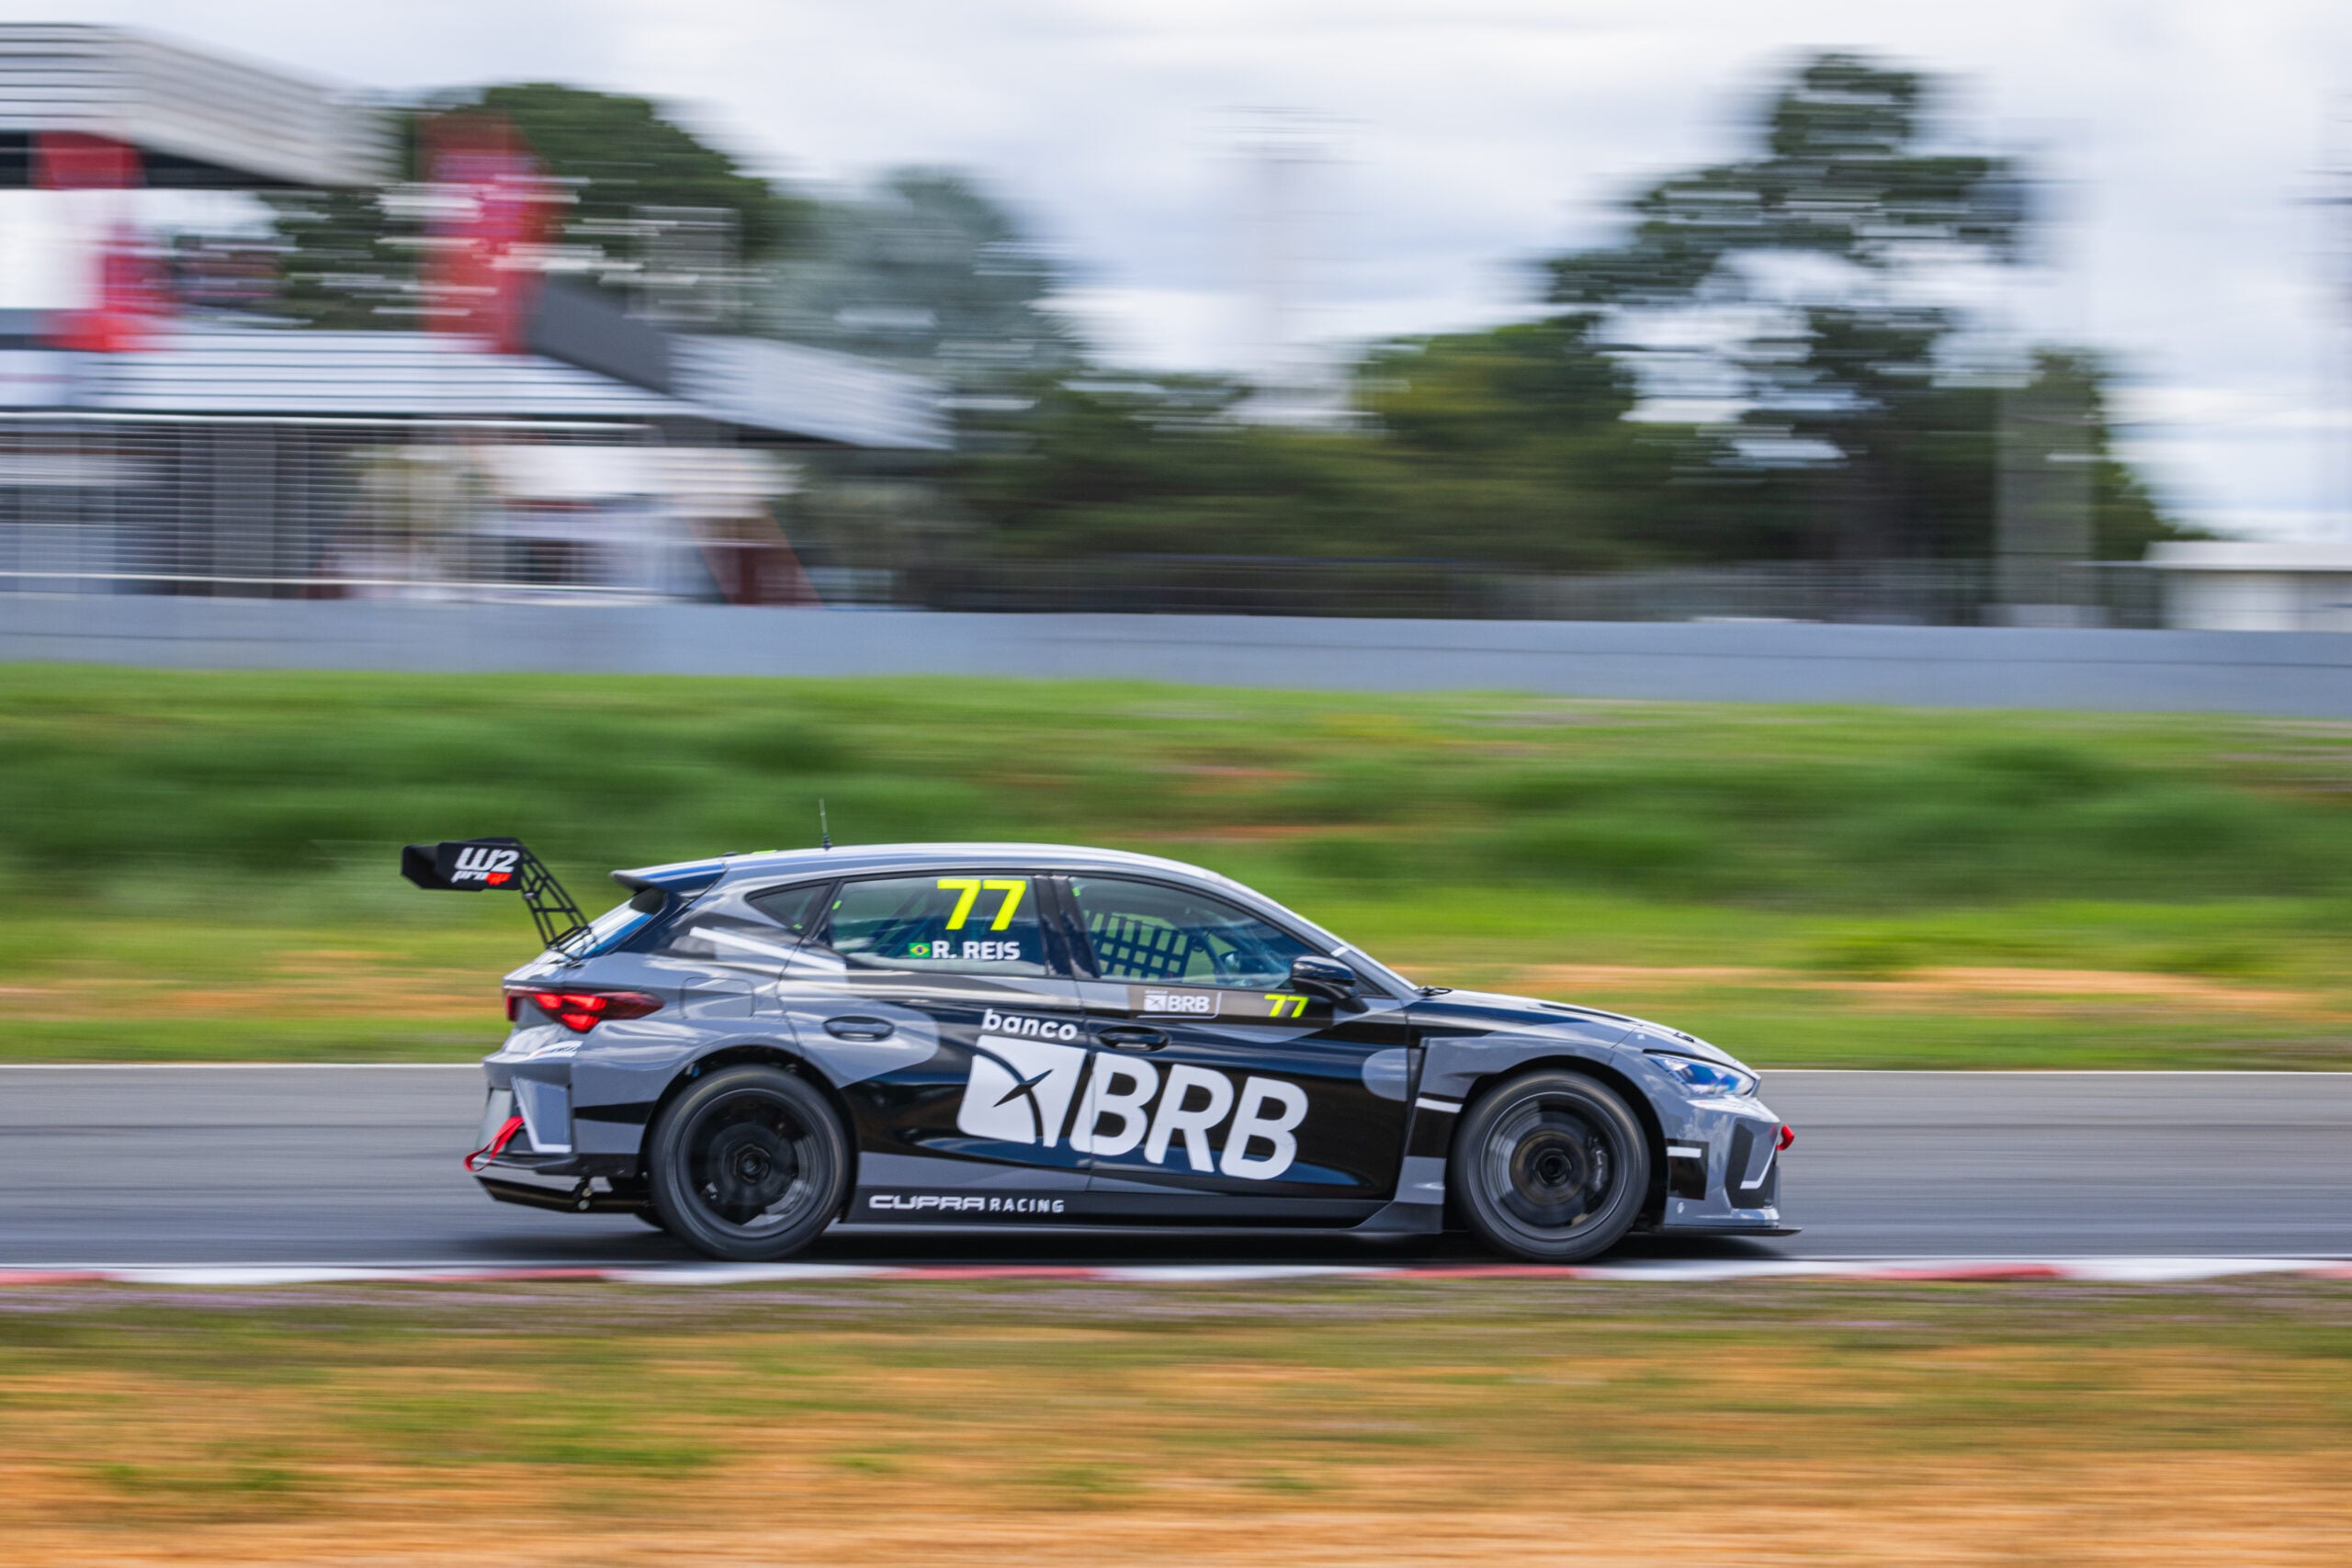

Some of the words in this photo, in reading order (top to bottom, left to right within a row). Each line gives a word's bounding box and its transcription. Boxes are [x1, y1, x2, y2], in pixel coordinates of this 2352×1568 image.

[454, 847, 520, 873] W2
[937, 878, 1026, 931] 77
[932, 940, 957, 959] R.
[962, 941, 1021, 961] REIS
[1168, 995, 1211, 1013] BRB
[1264, 993, 1309, 1019] 77
[981, 1009, 1078, 1041] banco
[1069, 1051, 1308, 1180] BRB
[868, 1195, 986, 1211] CUPRA
[989, 1197, 1065, 1213] RACING
